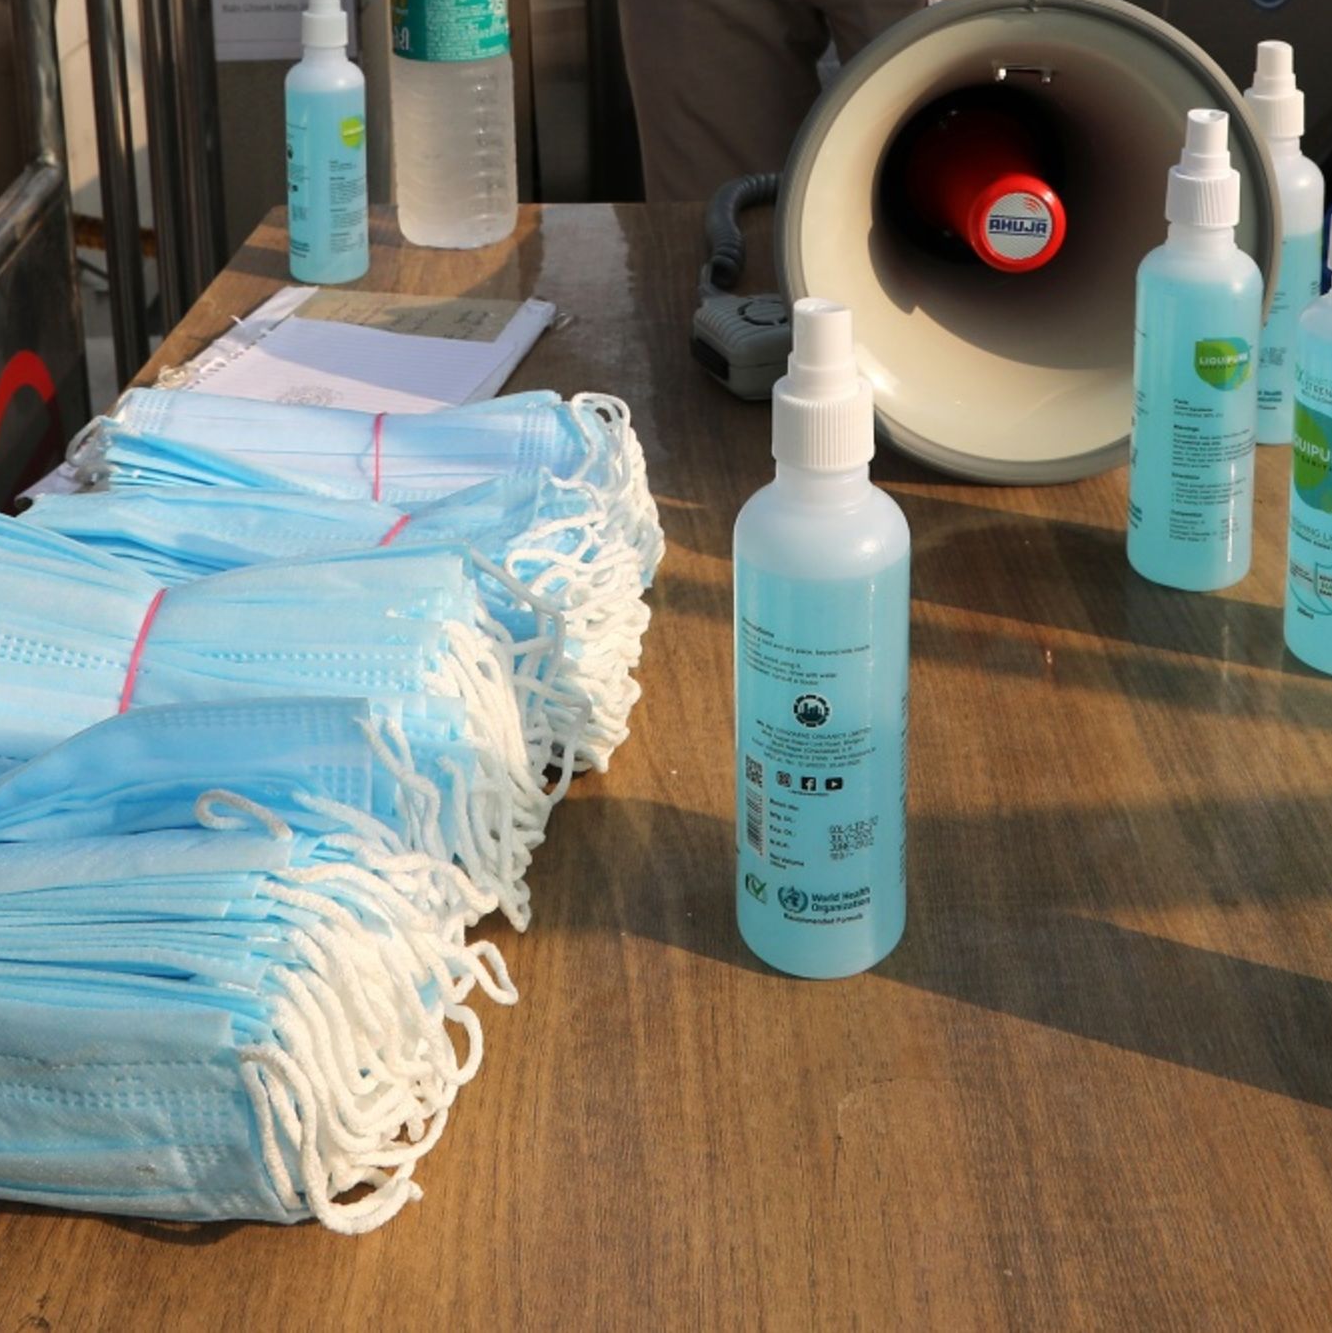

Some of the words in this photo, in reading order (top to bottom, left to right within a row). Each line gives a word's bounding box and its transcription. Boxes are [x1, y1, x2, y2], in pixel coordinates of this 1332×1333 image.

[988, 218, 1048, 234] AHUJA
[810, 891, 840, 903] World
[842, 886, 872, 902] Health
[810, 896, 872, 915] Organization
